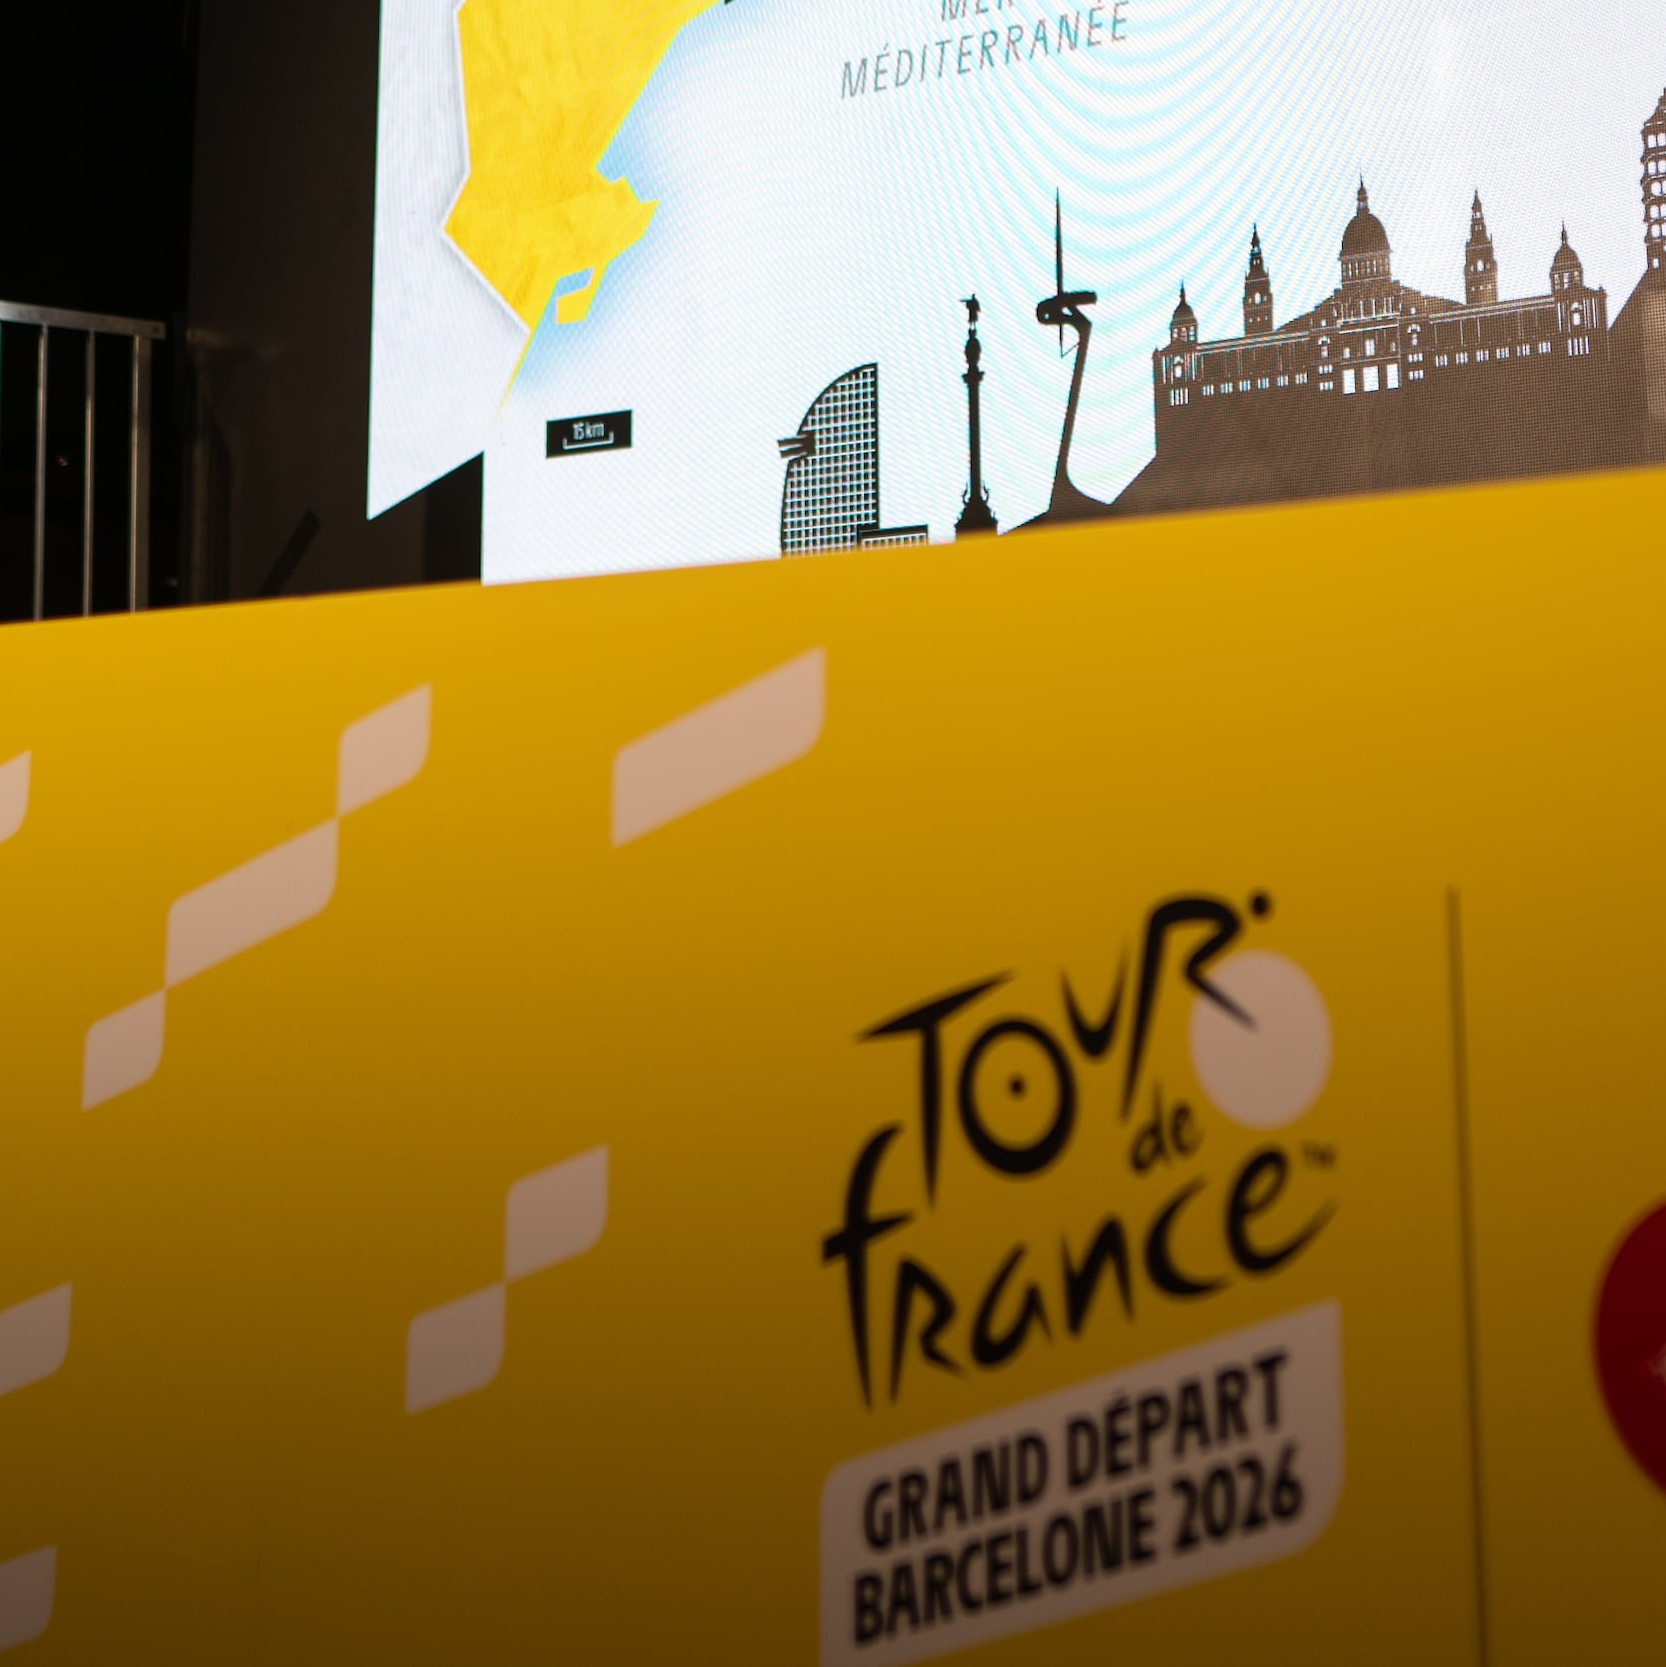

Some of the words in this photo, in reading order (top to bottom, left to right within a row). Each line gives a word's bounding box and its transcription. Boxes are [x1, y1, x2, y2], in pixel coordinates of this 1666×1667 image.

[586, 422, 605, 438] km
[1130, 1079, 1199, 1176] de
[863, 1433, 1049, 1555] GRAND
[1066, 1349, 1288, 1491] DÉPART
[852, 1490, 1156, 1649] BARCELONE
[1171, 1442, 1303, 1559] 2026
